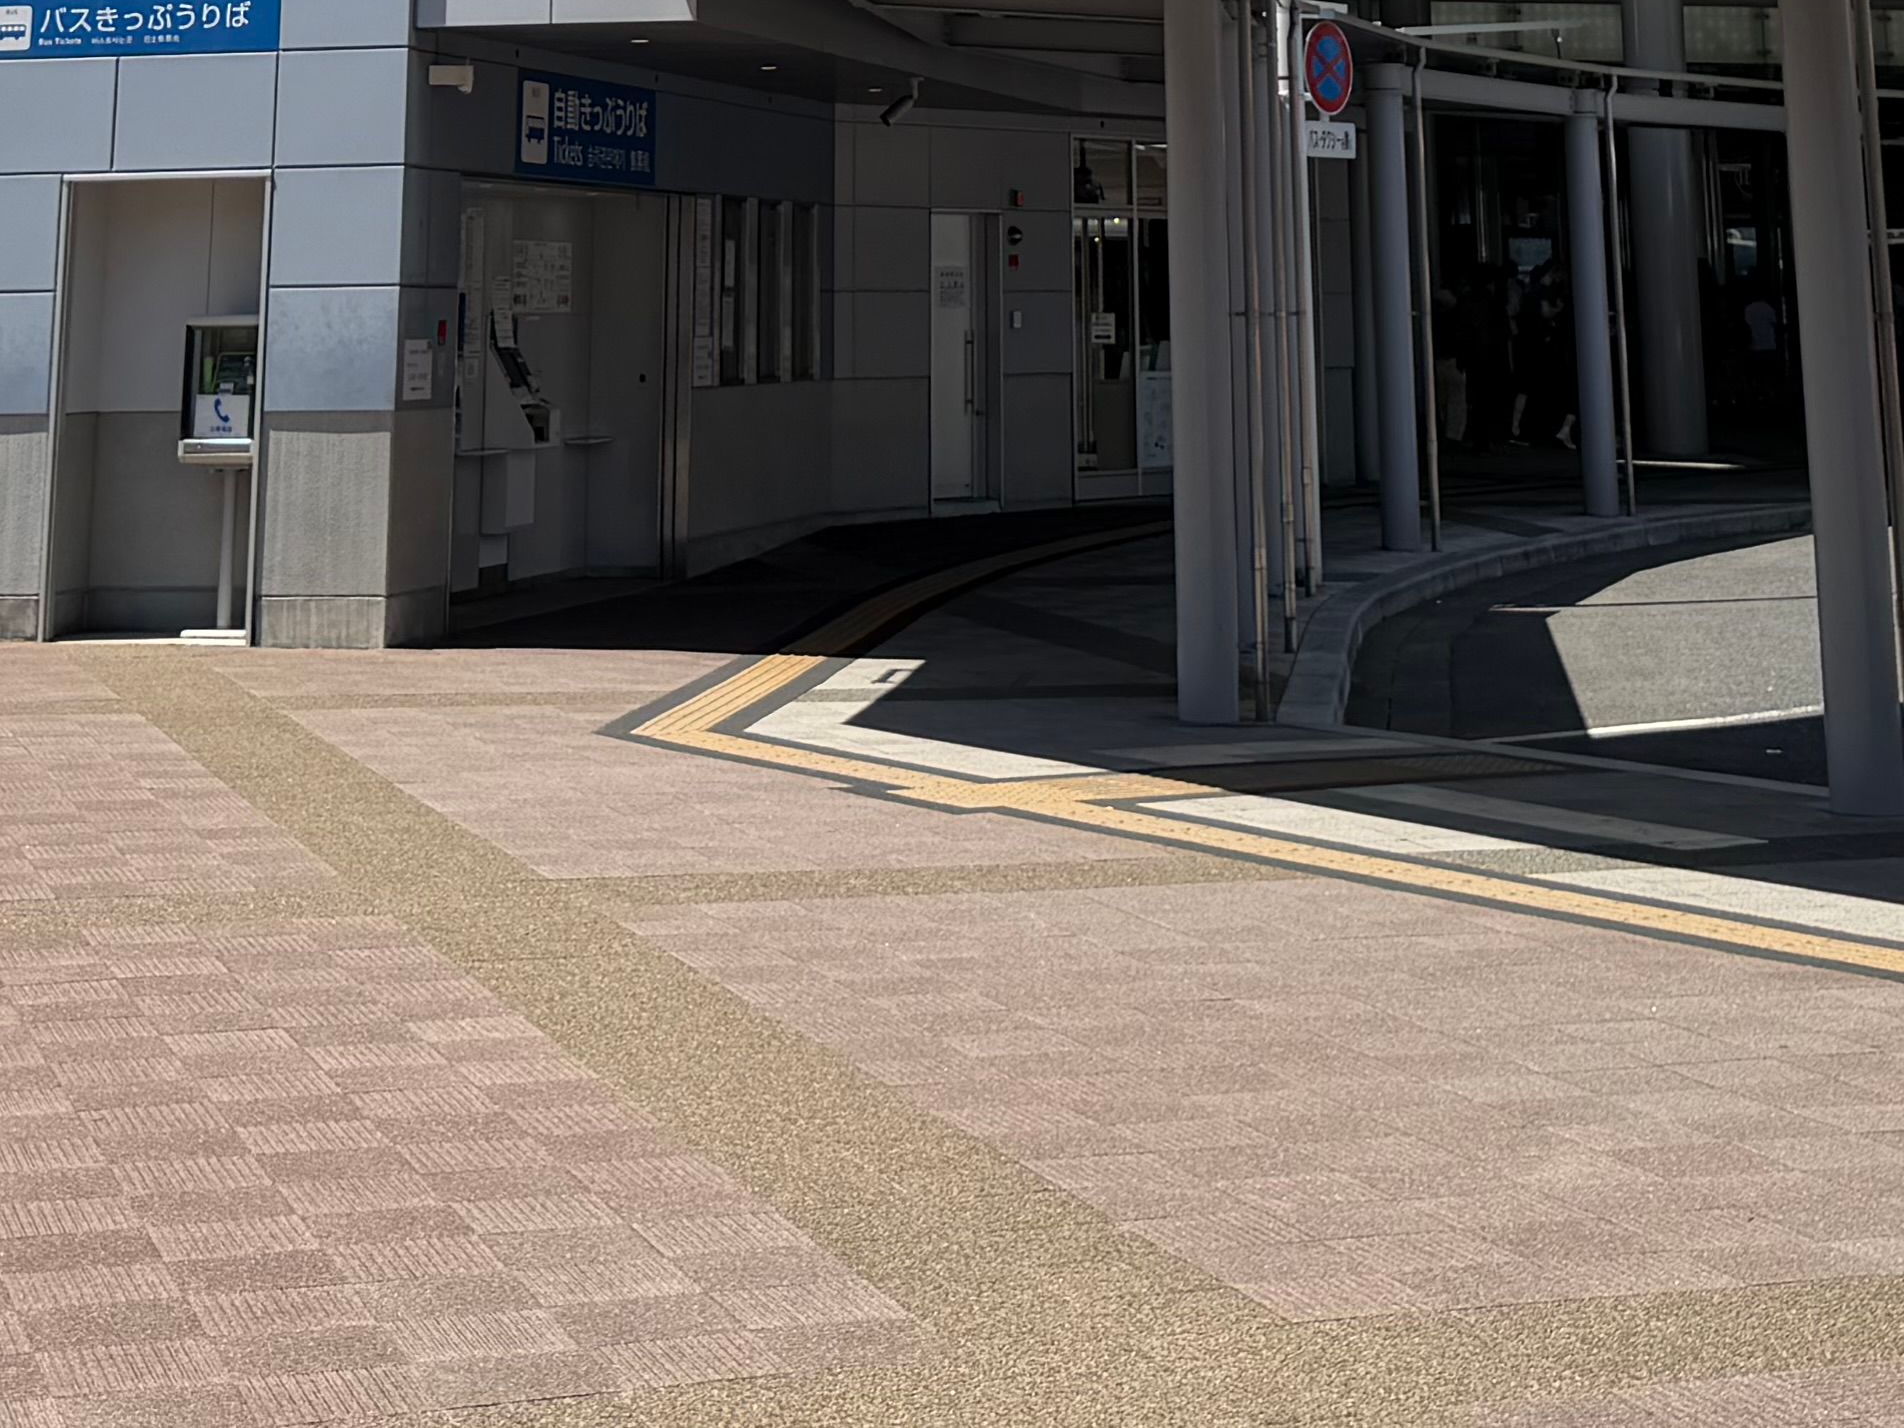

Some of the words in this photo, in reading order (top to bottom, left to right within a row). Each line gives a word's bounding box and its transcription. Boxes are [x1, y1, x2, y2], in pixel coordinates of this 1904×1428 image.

[39, 0, 252, 34] バスきっぷうりば
[553, 87, 649, 138] 自動きっぷうりば
[552, 135, 584, 167] Tickets
